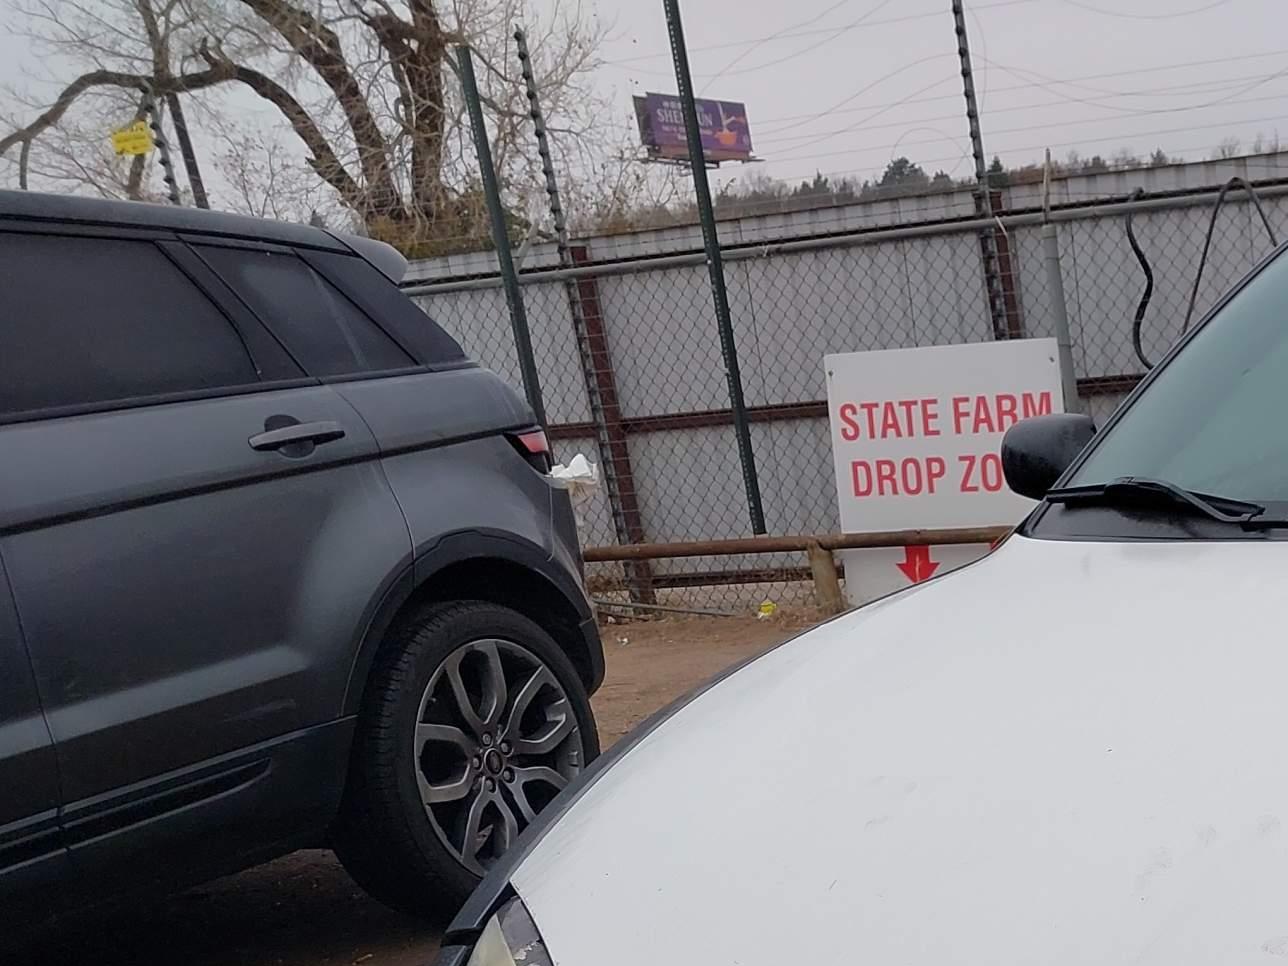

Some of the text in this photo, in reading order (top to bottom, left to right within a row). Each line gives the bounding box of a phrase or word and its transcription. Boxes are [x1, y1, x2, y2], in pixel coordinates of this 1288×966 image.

[696, 112, 713, 127] UN
[839, 391, 1053, 442] STATE FARM
[851, 453, 1002, 498] DROP ZO
